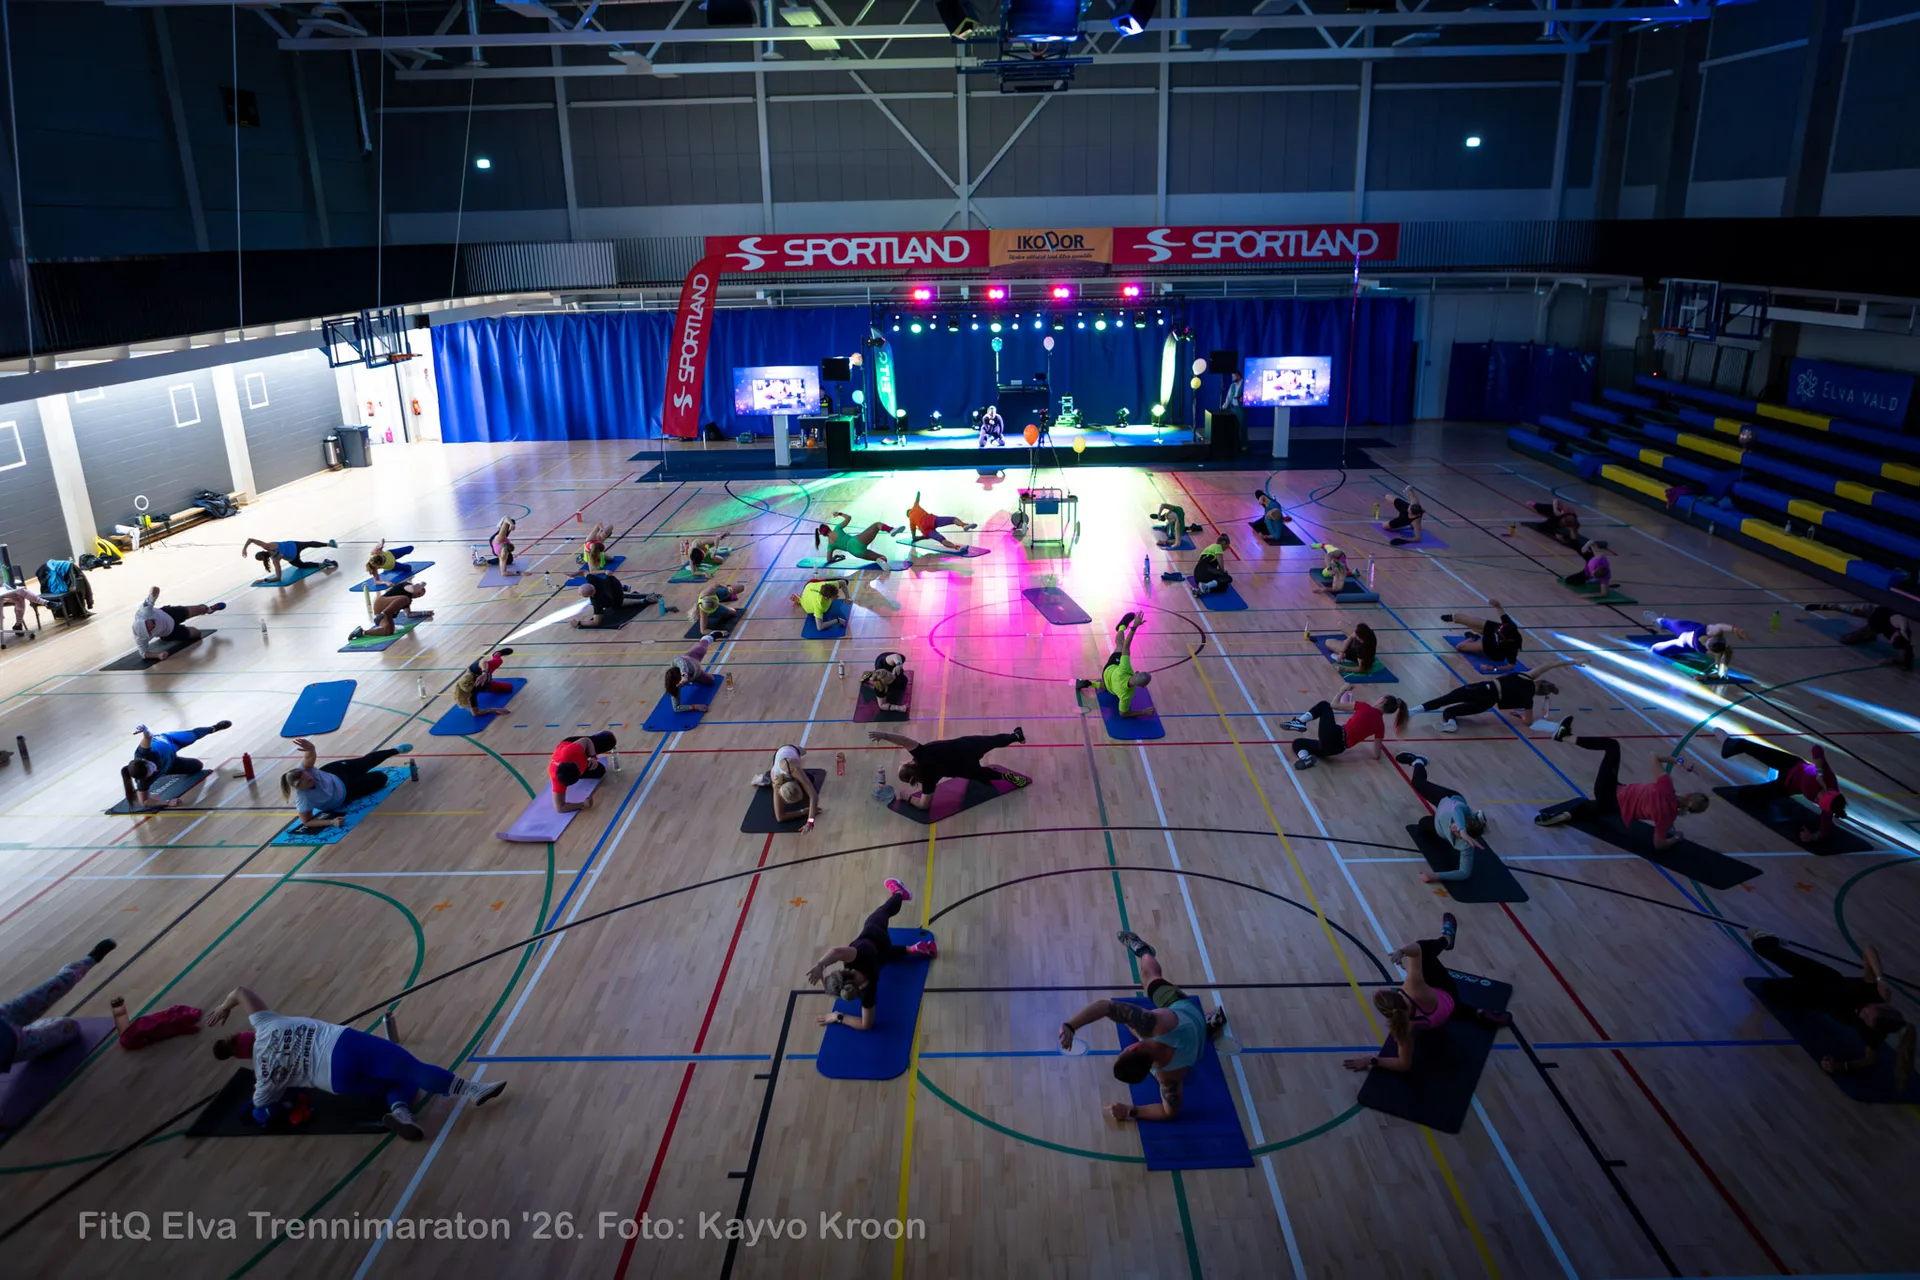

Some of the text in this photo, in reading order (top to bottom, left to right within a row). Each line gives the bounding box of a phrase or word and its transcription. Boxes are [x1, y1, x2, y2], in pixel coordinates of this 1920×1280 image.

[784, 236, 970, 267] SPORTLAND
[1018, 231, 1084, 252] IKODOR
[1192, 229, 1379, 259] SPORTLAND
[678, 273, 710, 384] SPORTLAND
[1823, 381, 1899, 411] ELVA VALD
